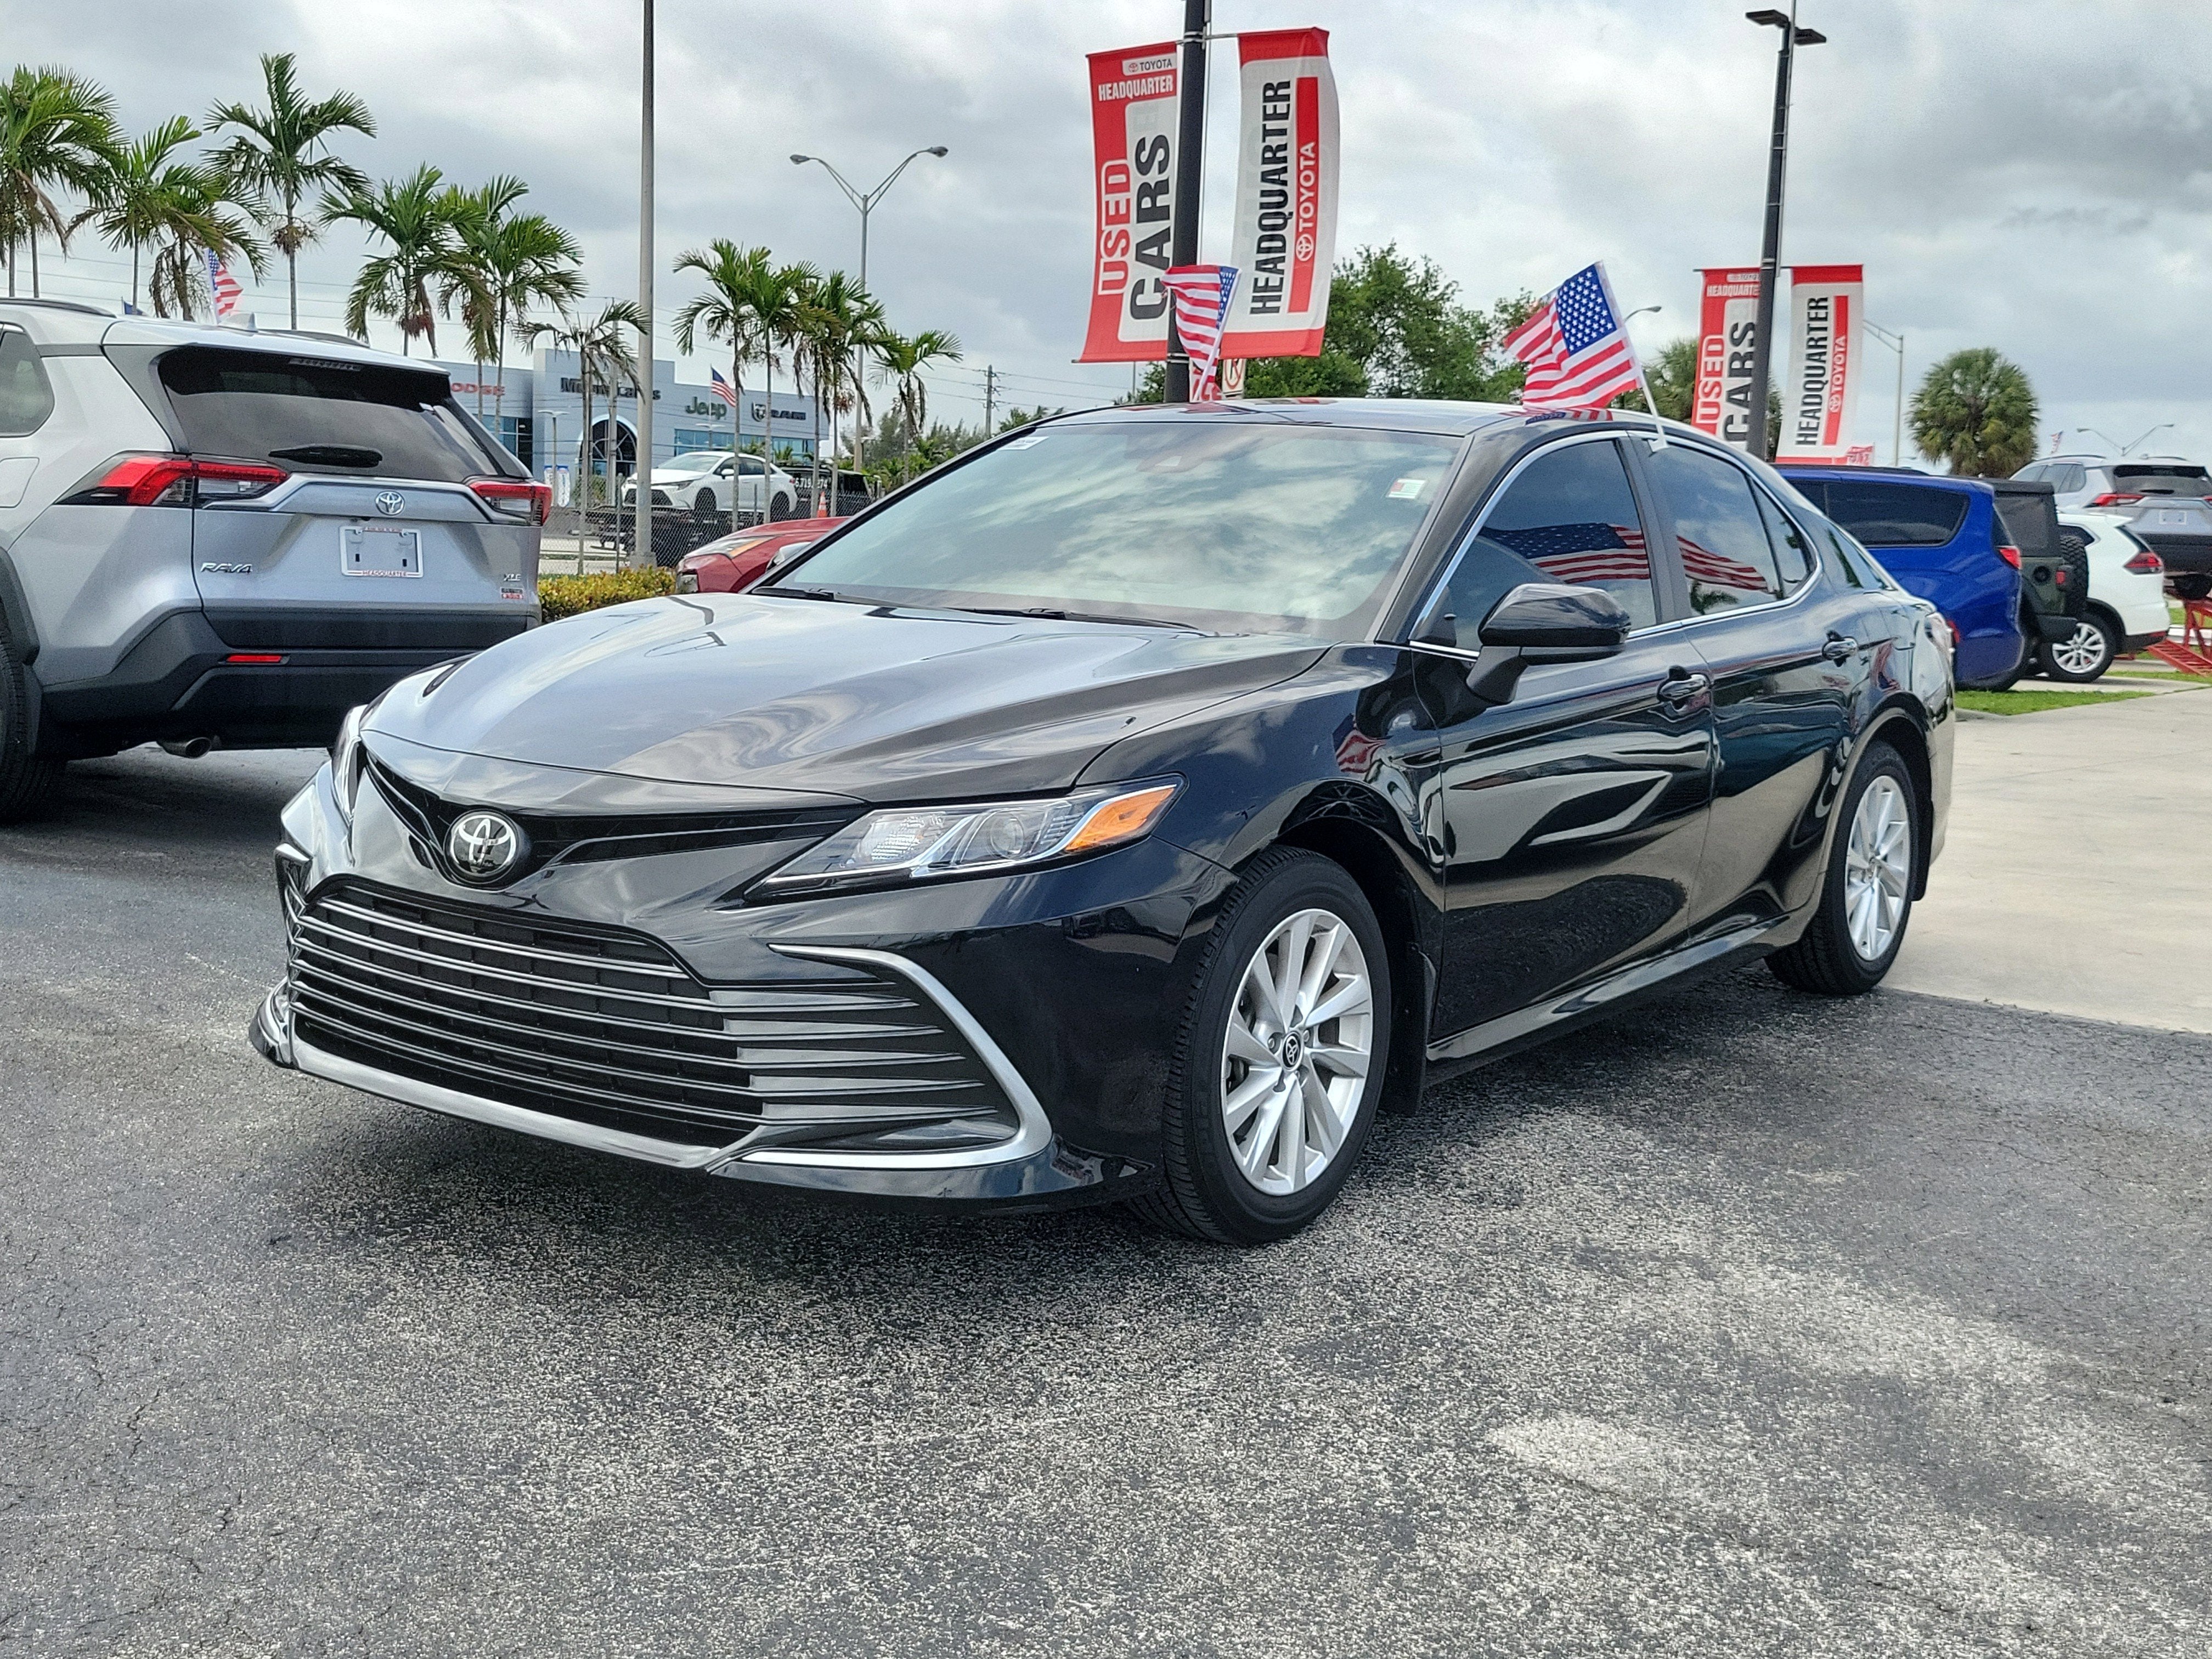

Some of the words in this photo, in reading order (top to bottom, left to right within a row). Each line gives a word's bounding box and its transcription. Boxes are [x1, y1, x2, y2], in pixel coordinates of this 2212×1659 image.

[1098, 75, 1173, 101] HEADQUARTER
[1139, 59, 1172, 71] TOYOTA
[1250, 80, 1294, 315] HEADQUARTER
[1298, 142, 1315, 232] TOYOTA
[1099, 160, 1131, 295] USED
[1130, 134, 1171, 320] CARS
[1707, 284, 1759, 297] HEADQUARTE
[451, 383, 505, 396] ODGE
[1696, 335, 1724, 424] USED
[1724, 322, 1756, 442] CARS
[1796, 297, 1829, 445] HEADQUARTER
[1833, 336, 1846, 392] TOYOTA
[685, 396, 727, 420] Jeep
[771, 410, 806, 420] RAM
[200, 562, 252, 573] RAV4
